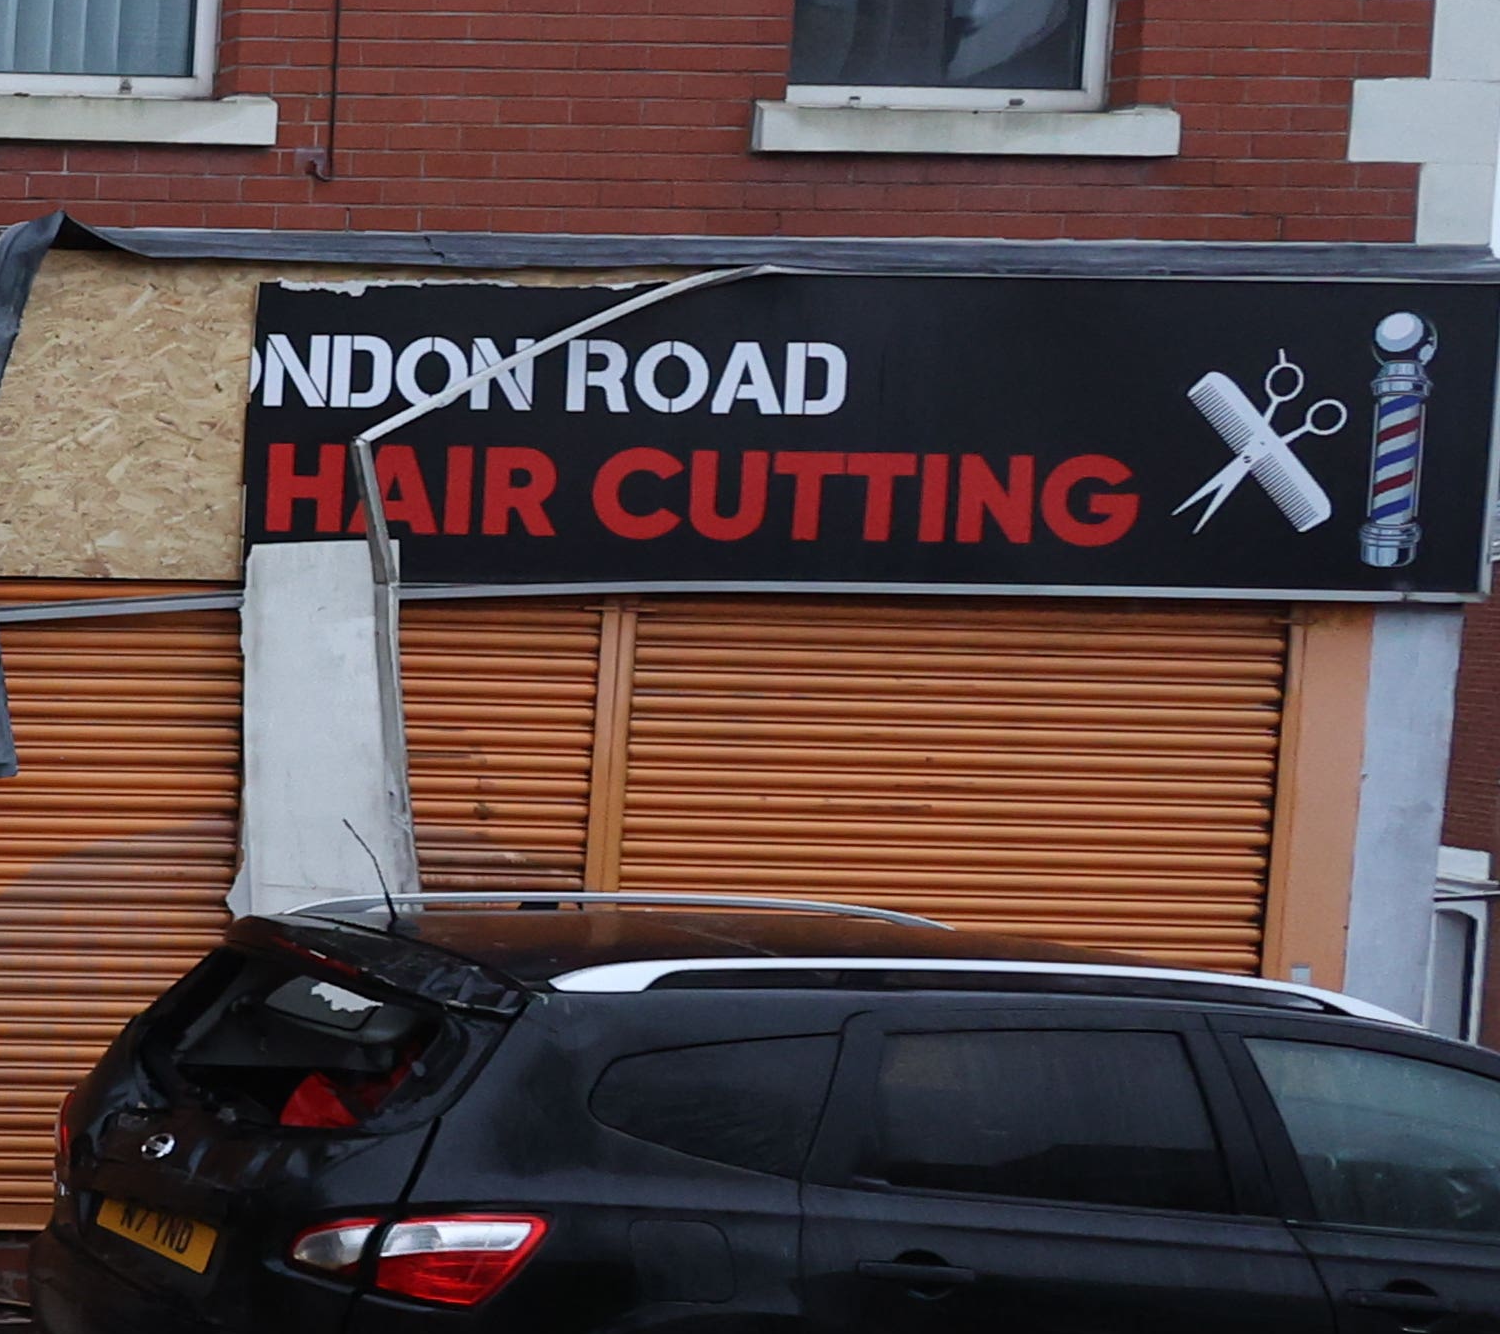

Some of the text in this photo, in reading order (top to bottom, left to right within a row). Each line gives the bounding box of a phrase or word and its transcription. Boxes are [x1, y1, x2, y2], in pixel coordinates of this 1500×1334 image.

[250, 334, 848, 416] NDON ROAD
[265, 442, 1141, 548] HAIR CUTTING
